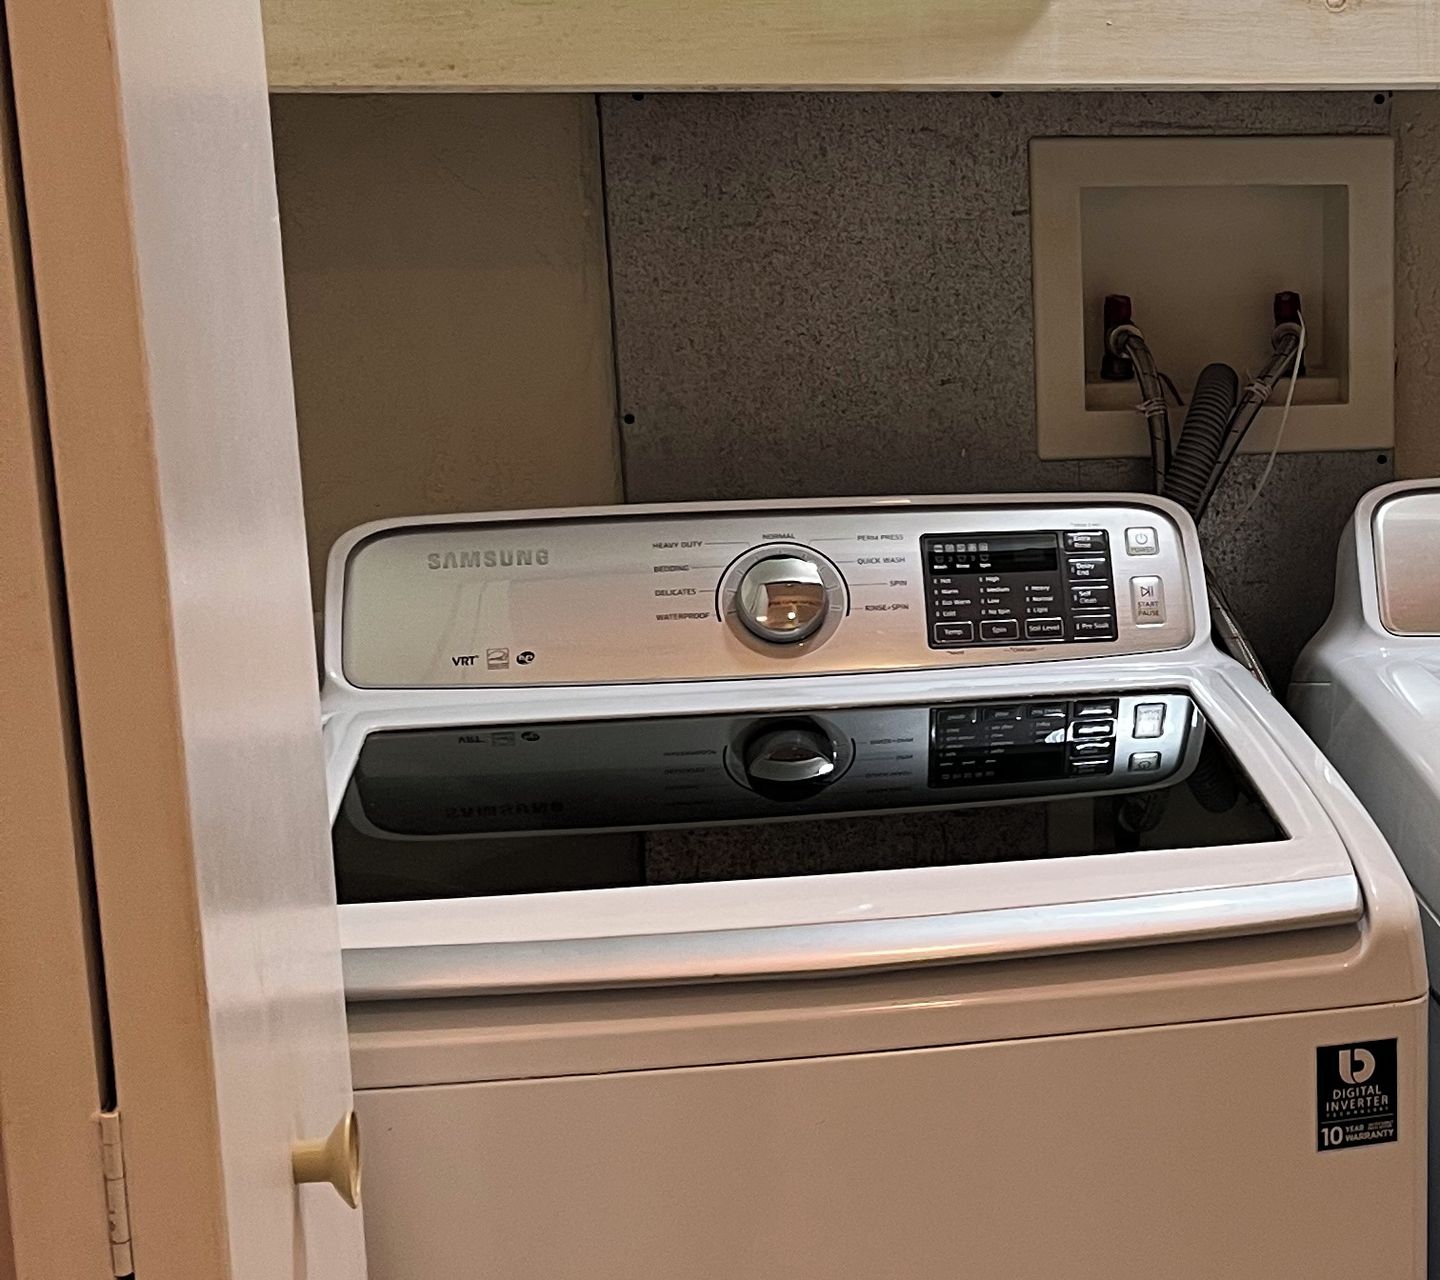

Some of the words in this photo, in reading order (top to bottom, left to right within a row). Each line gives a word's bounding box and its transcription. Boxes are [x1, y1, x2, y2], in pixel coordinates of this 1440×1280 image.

[427, 547, 549, 570] SAMSUNG
[857, 557, 881, 565] QUICK
[654, 588, 697, 597] DELICATES
[655, 612, 710, 621] WATERPROOF
[1333, 1084, 1382, 1100] DIGITAL
[1326, 1095, 1388, 1112] INVERTER
[1321, 1125, 1344, 1146] 10
[1345, 1129, 1394, 1142] WARRANTY
